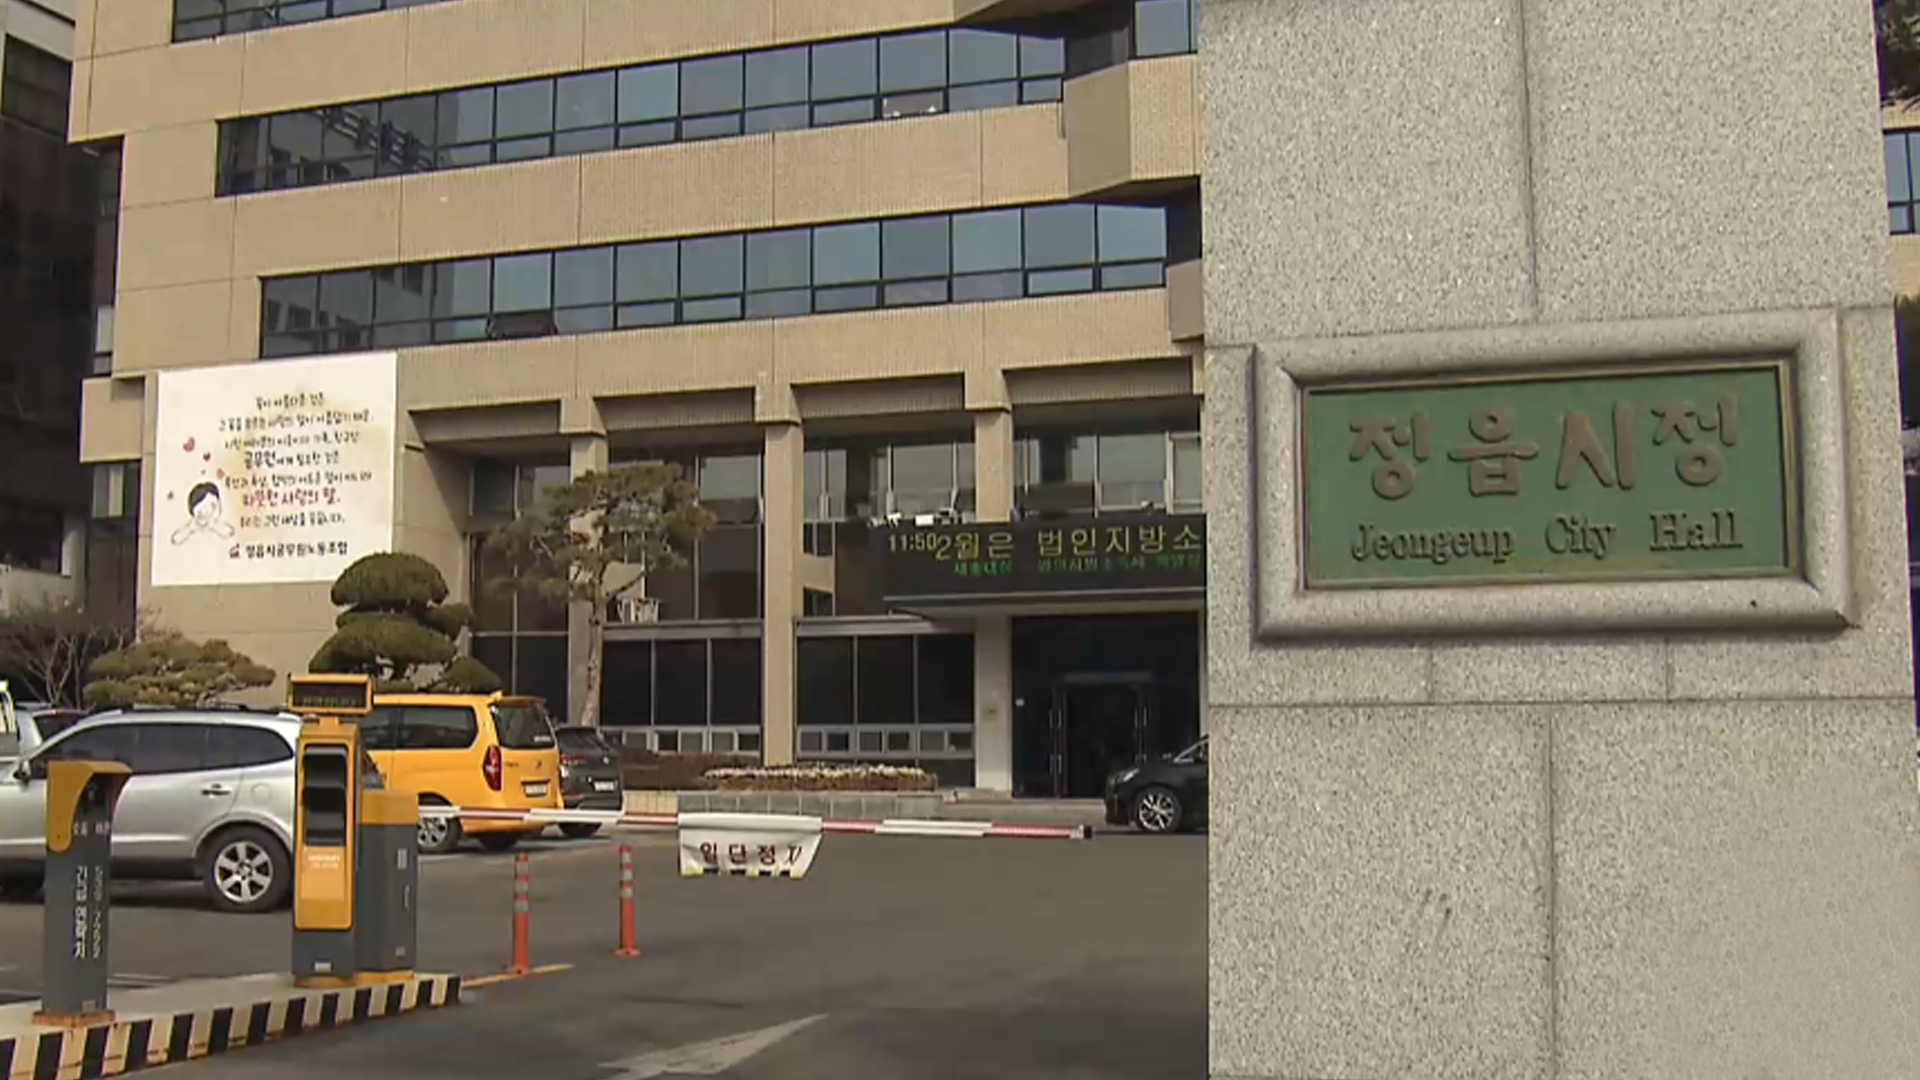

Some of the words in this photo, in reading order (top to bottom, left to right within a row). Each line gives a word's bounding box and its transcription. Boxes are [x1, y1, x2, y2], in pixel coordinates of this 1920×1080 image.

[244, 450, 294, 470] 공무원에게
[1037, 525, 1202, 557] 법인지방소
[1351, 523, 1516, 565] Jeongeup
[1545, 512, 1617, 560] City
[1649, 506, 1744, 552] Hall
